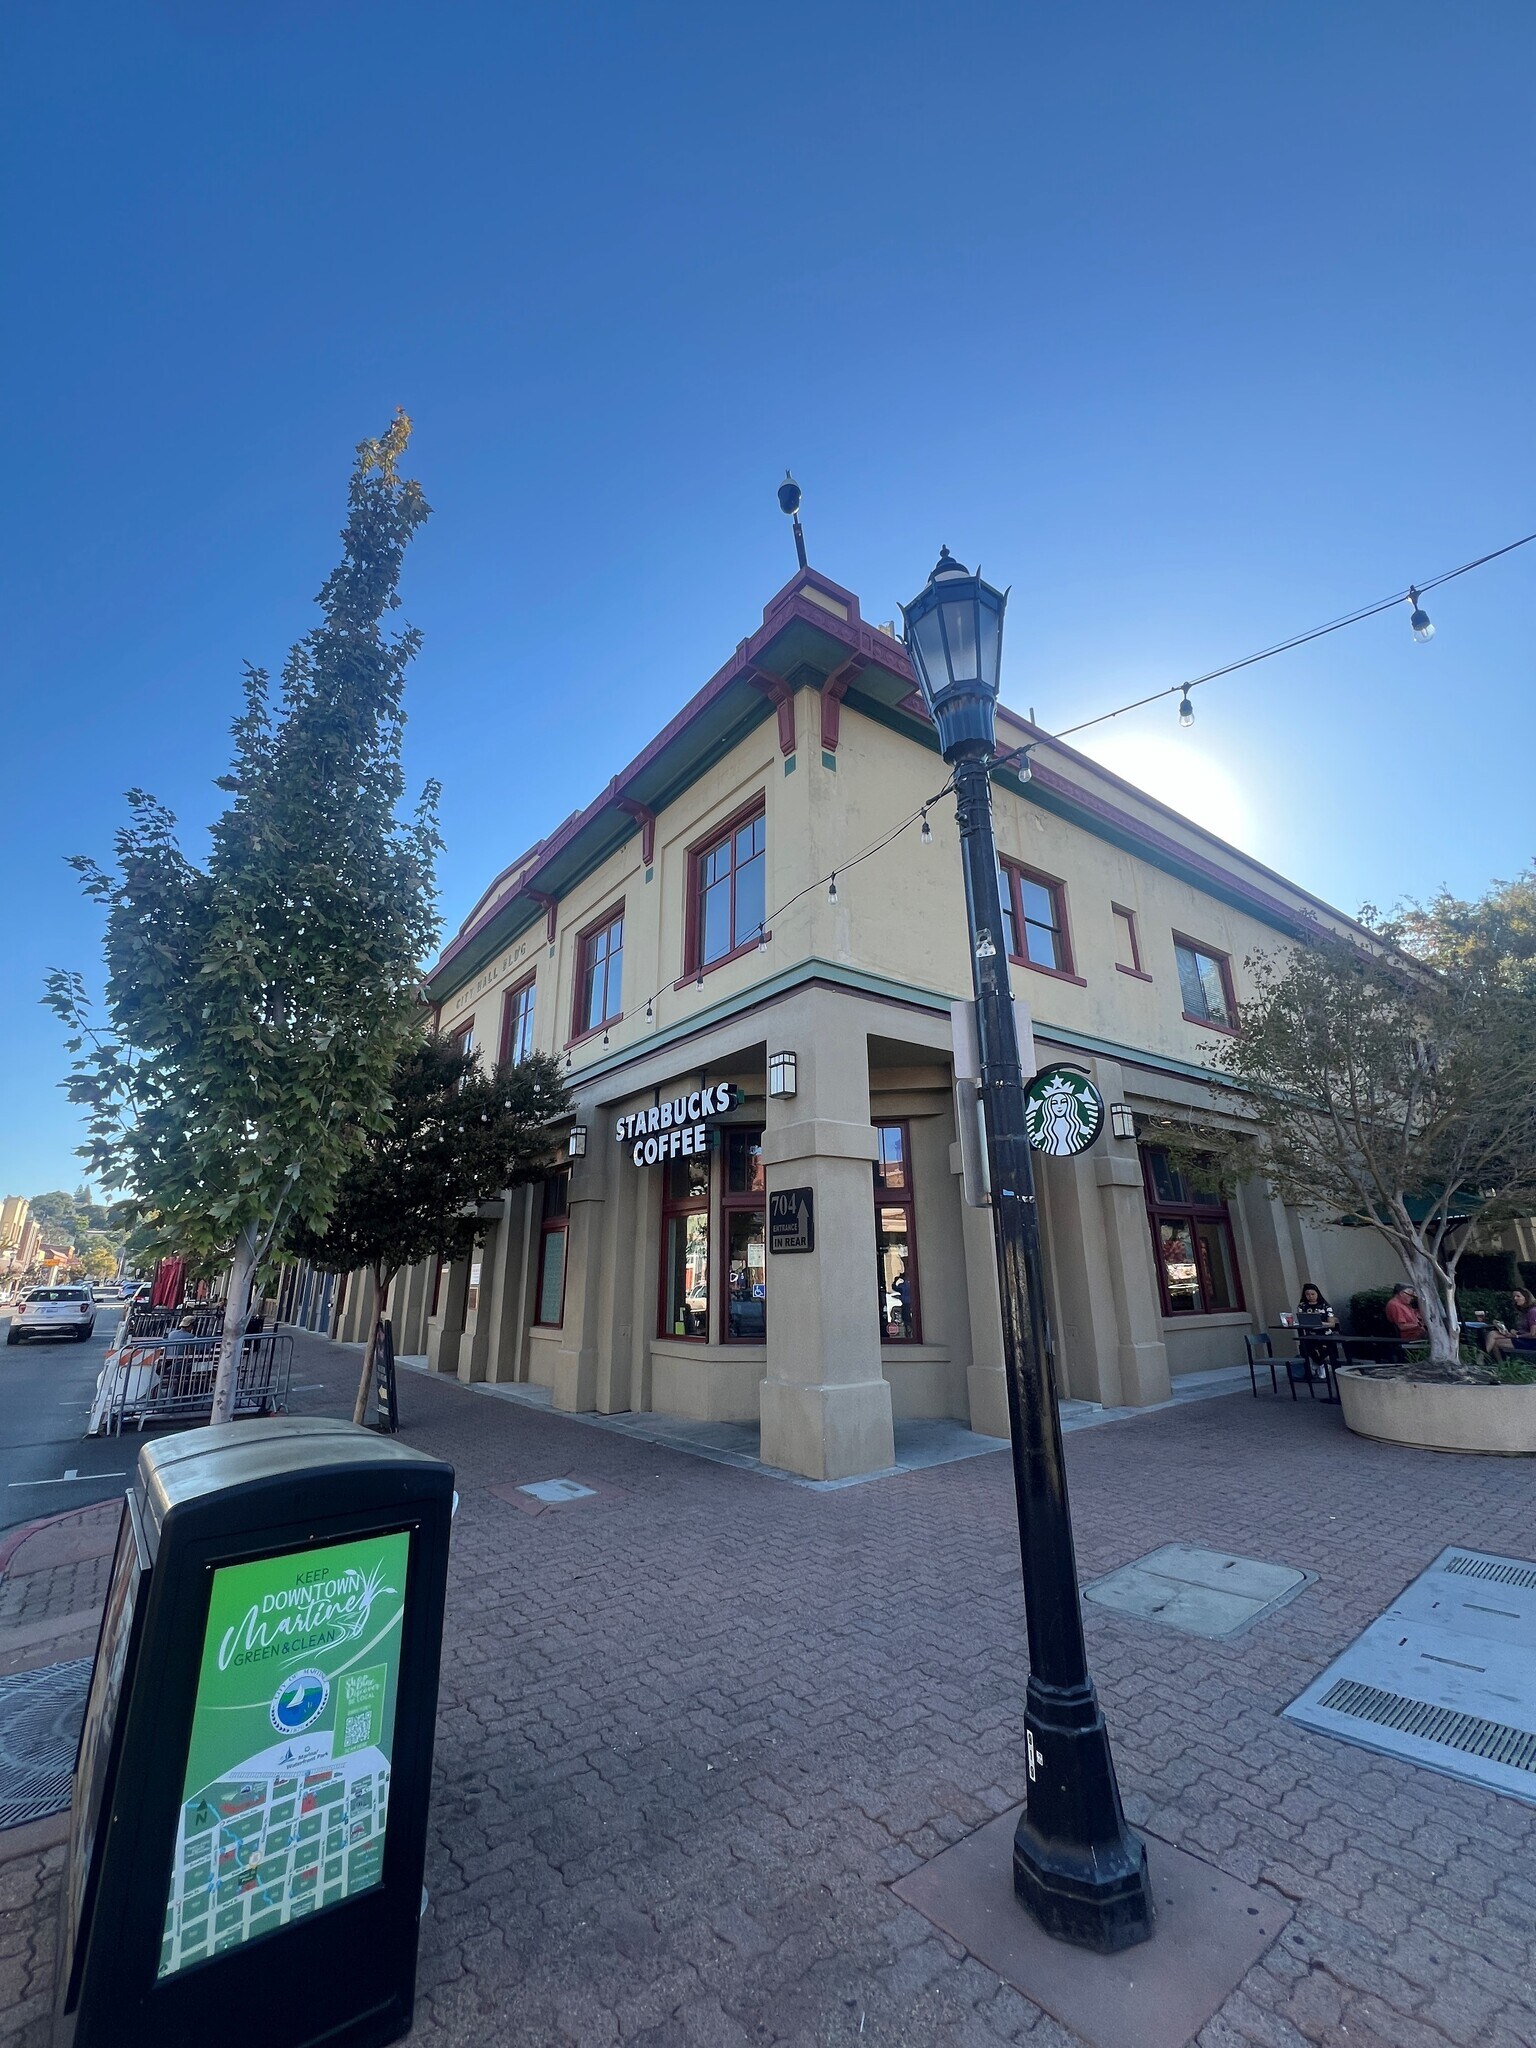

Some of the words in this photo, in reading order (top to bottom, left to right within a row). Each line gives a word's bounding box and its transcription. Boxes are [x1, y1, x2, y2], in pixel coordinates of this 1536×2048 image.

[456, 988, 474, 1009] CITY
[477, 968, 498, 993] HALL
[616, 1082, 730, 1142] STARBUCKS
[633, 1123, 706, 1167] COFFEE
[771, 1193, 796, 1217] 704
[773, 1223, 798, 1233] ENTRANCE
[774, 1239, 783, 1248] IN
[785, 1236, 806, 1247] REAR
[296, 1567, 329, 1586] KEEP
[262, 1575, 360, 1614] DOWNTOWN
[195, 1811, 208, 1826] N
